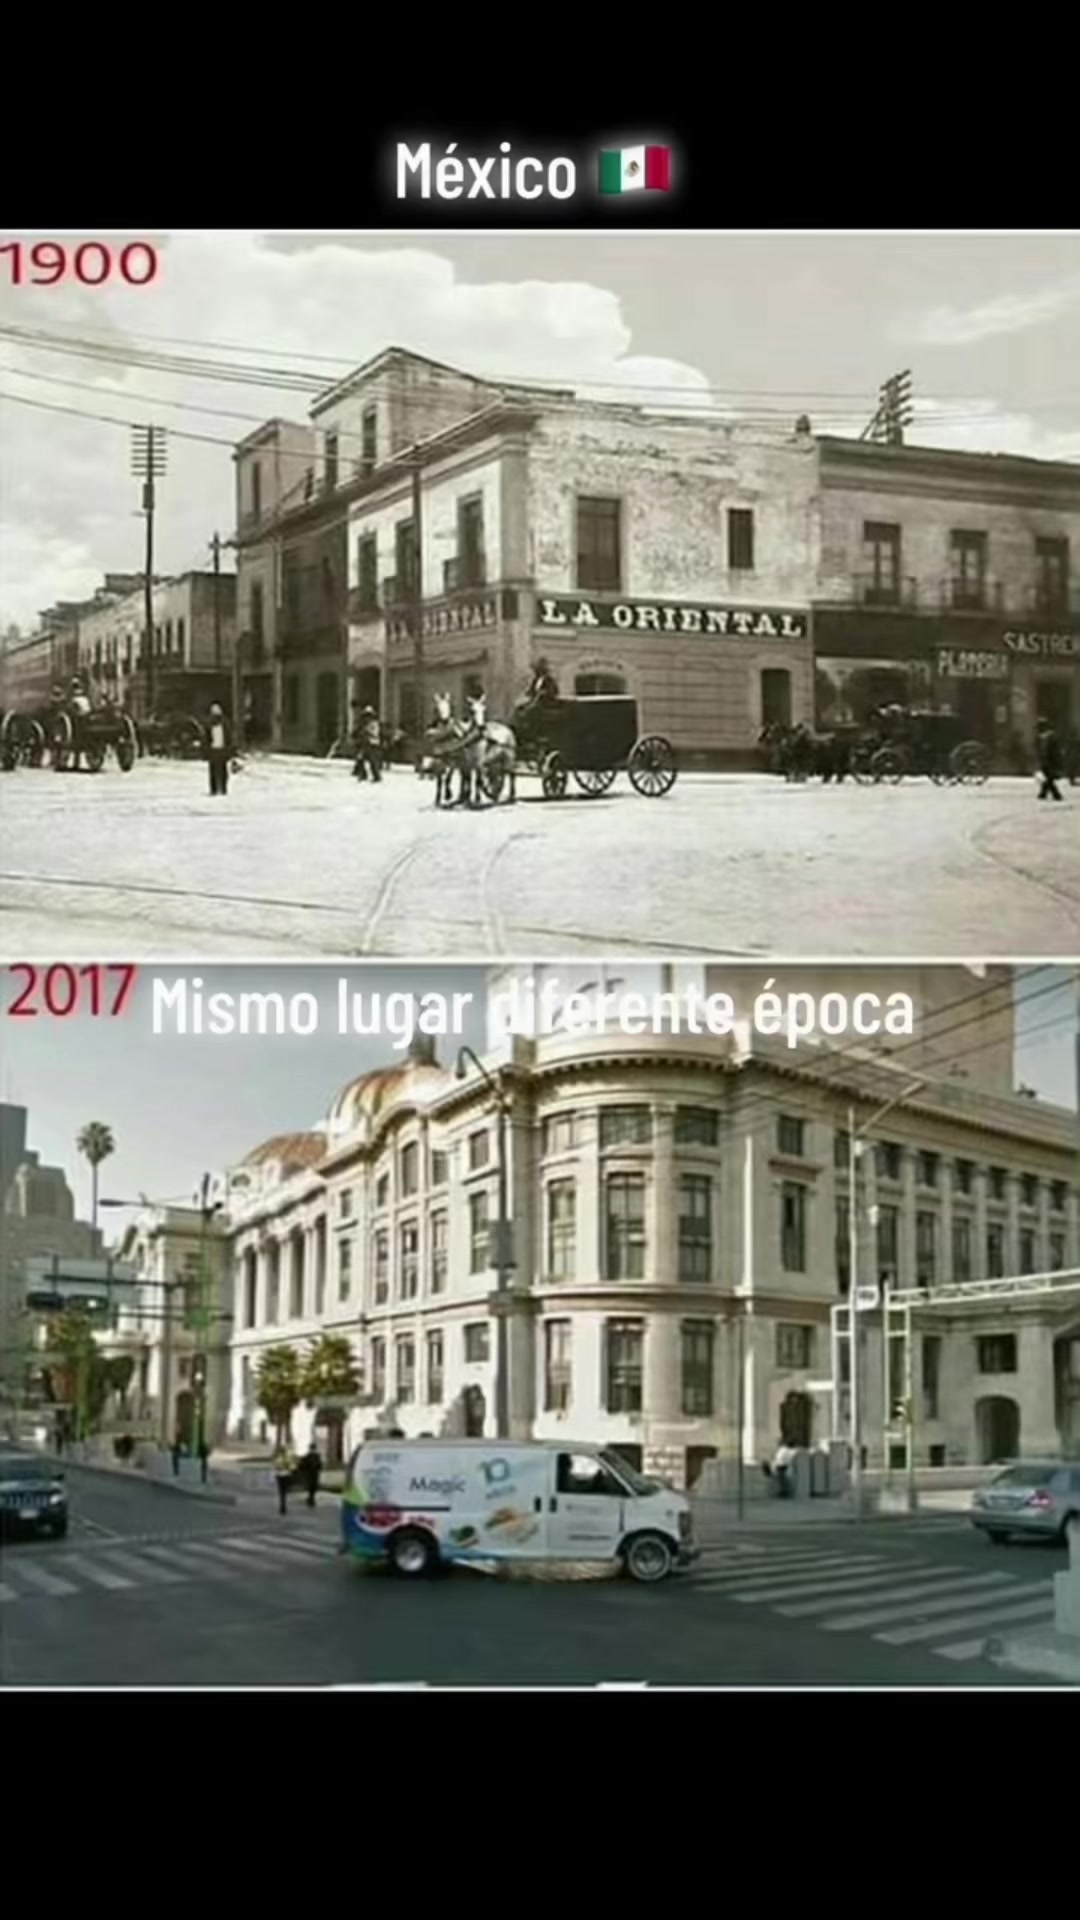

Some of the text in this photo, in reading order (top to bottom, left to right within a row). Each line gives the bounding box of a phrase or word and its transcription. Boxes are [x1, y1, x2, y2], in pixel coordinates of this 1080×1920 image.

[541, 600, 802, 637] LA ORIENTAL
[409, 1475, 466, 1494] Magic
